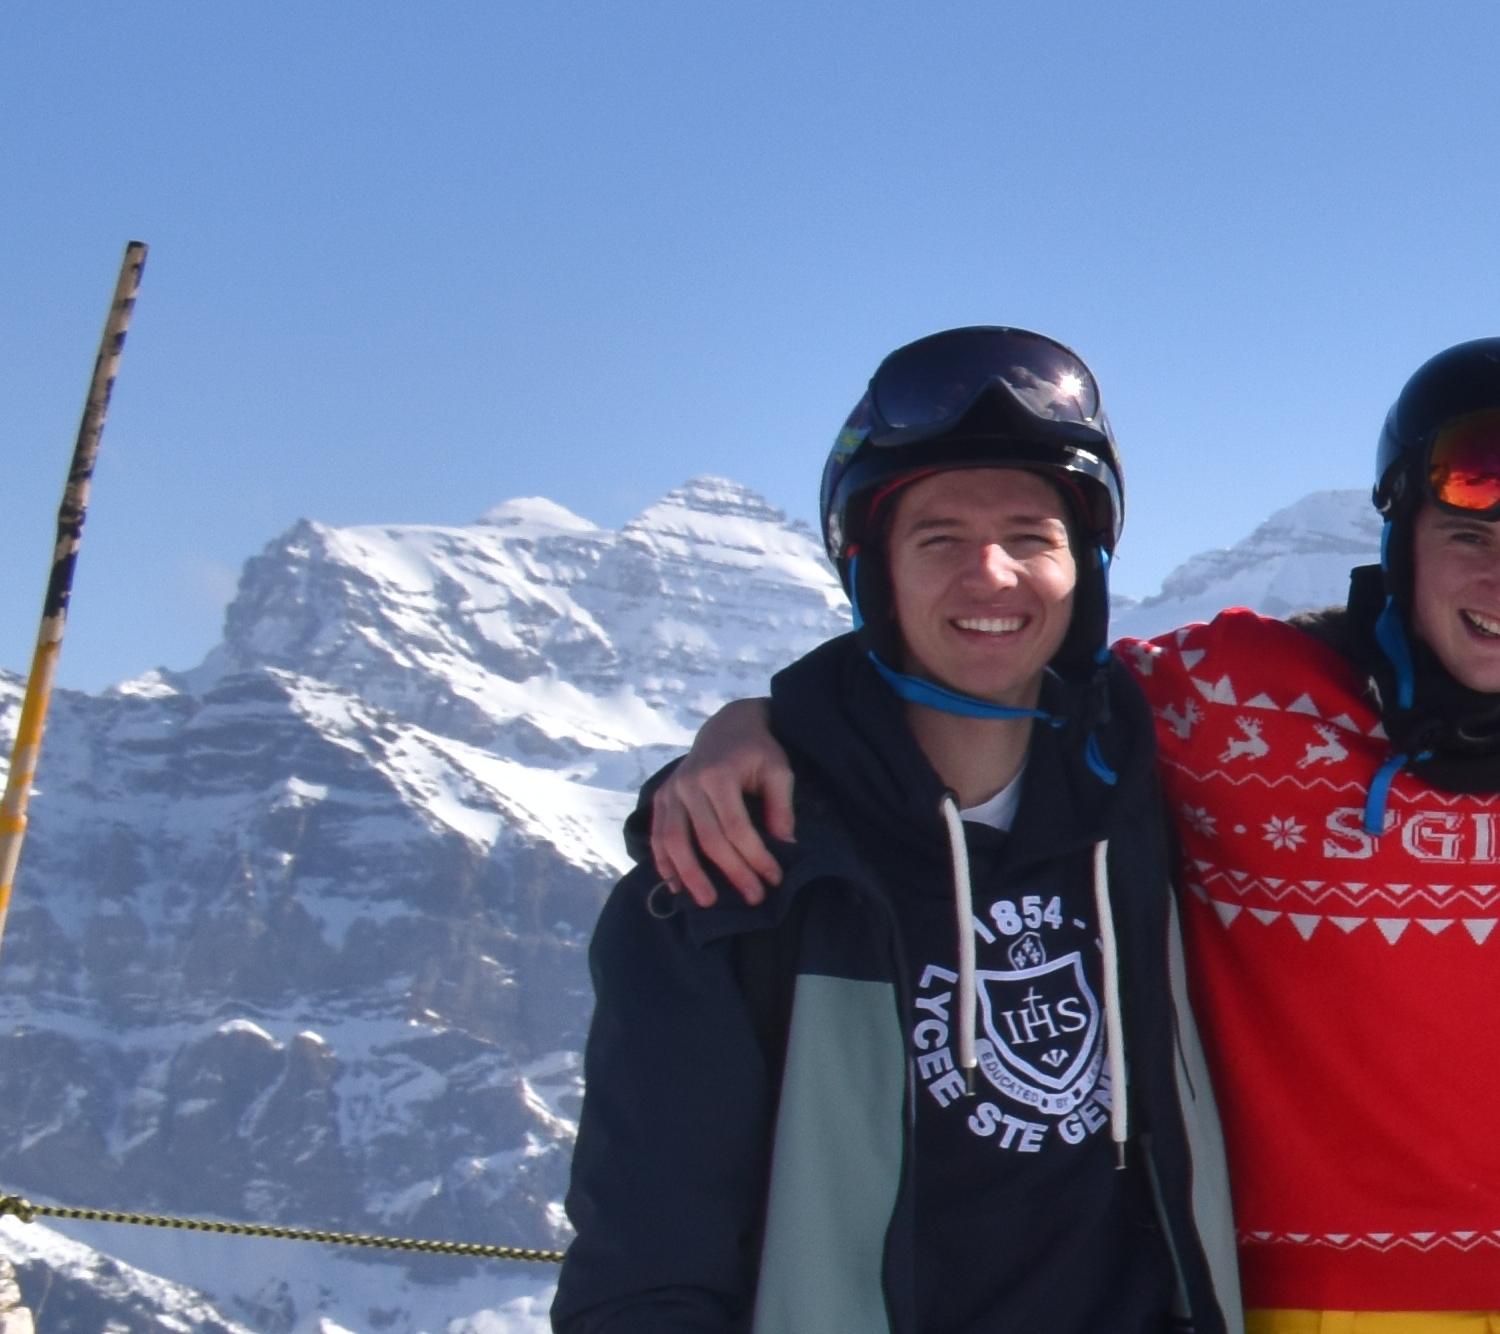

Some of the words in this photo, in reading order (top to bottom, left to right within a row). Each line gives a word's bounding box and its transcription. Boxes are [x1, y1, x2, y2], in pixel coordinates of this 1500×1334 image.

[1001, 989, 1088, 1045] IHS
[914, 963, 968, 1109] LYCEE
[968, 1103, 1048, 1154] STE
[981, 1051, 1039, 1104] EDUCATED
